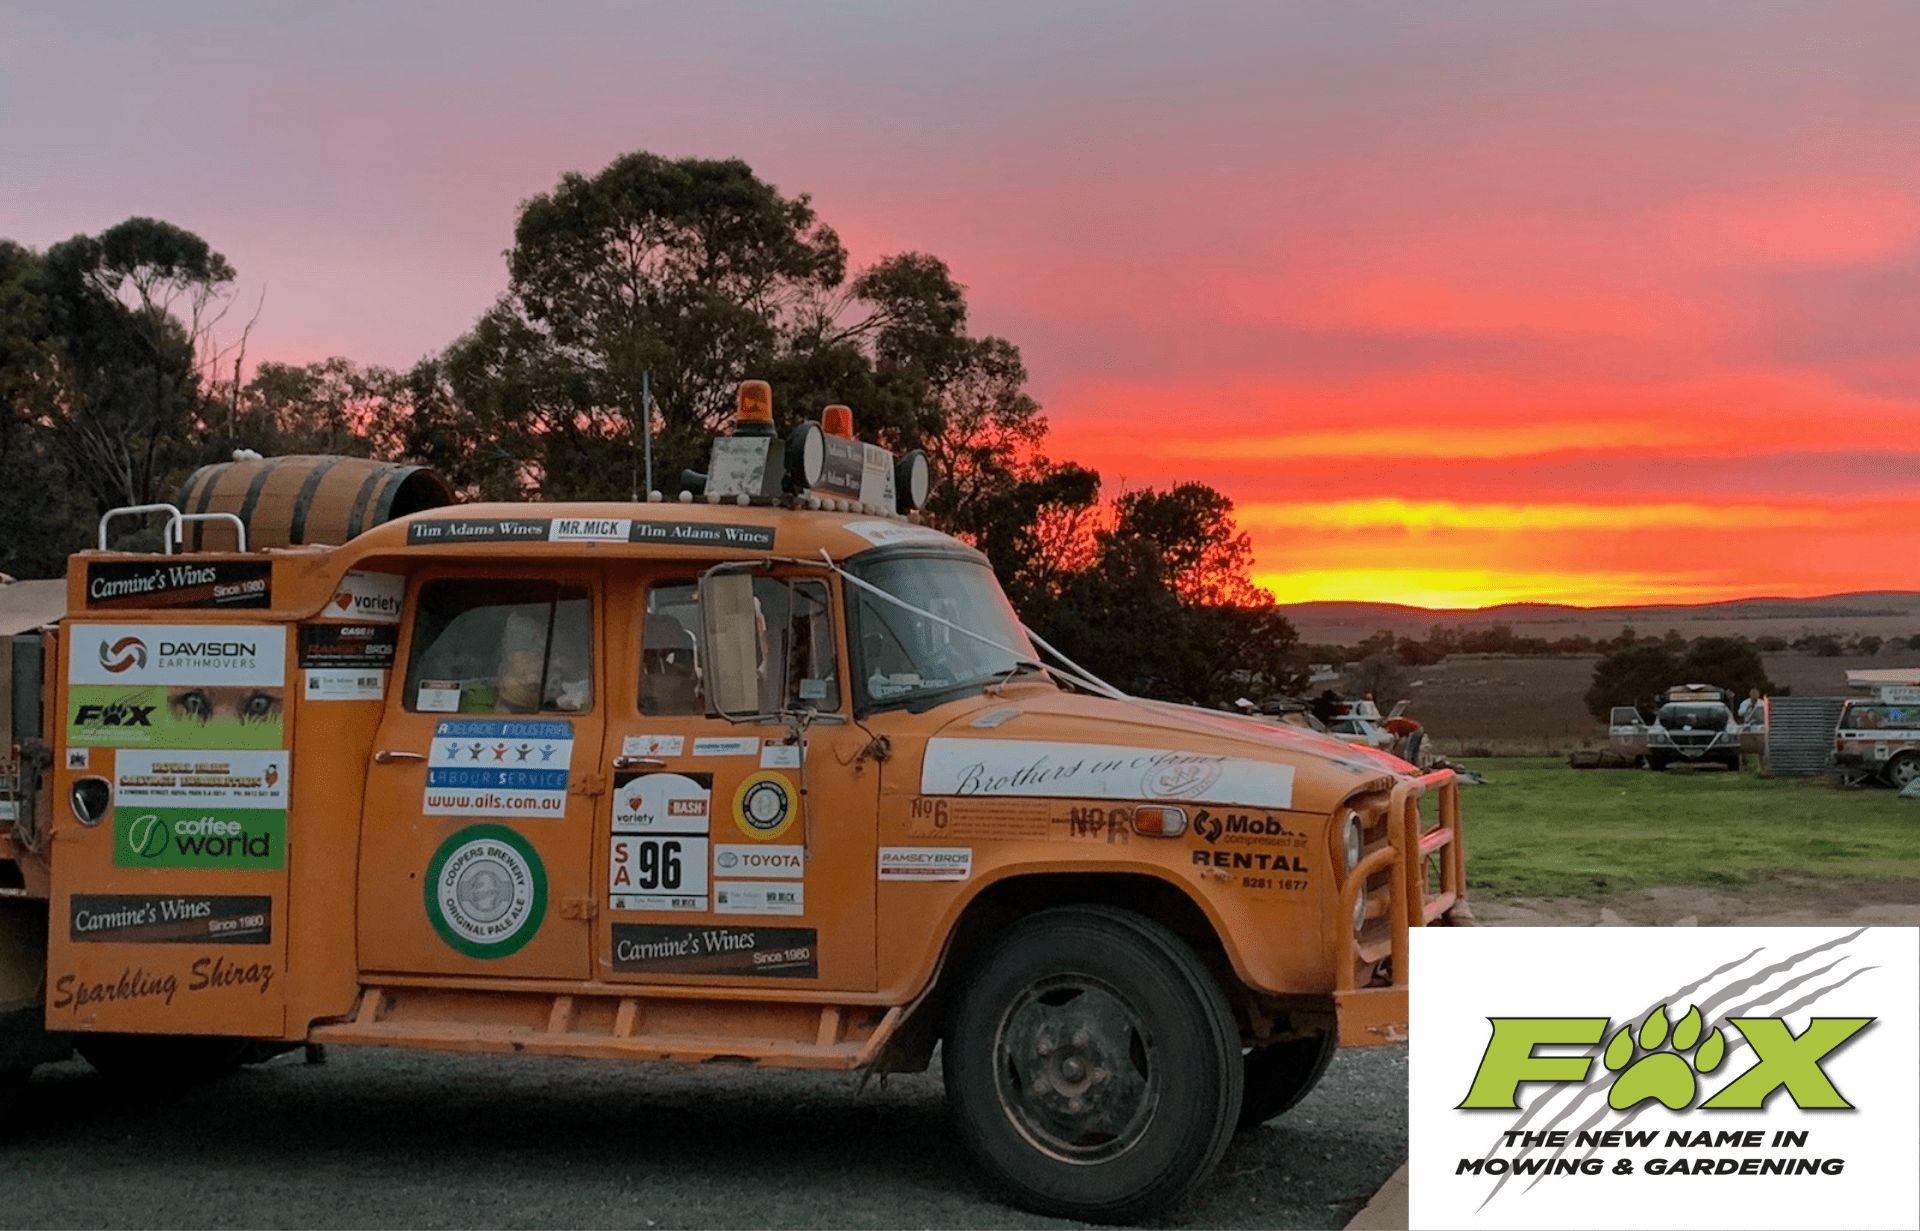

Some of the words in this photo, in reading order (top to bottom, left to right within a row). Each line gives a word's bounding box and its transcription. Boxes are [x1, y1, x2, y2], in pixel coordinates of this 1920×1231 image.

[413, 524, 442, 537] Tim
[446, 523, 495, 536] Adams
[500, 522, 543, 535] Wines
[637, 525, 666, 537] Tim
[671, 526, 721, 540] Adams
[725, 528, 769, 543] Wines
[91, 569, 166, 599] Carmine's
[168, 565, 216, 587] Wines
[213, 585, 239, 597] Since
[354, 594, 401, 614] variety
[160, 642, 256, 656] DAVISON
[158, 658, 256, 669] EARTHMOVERS
[499, 772, 567, 785] SERVICE
[955, 755, 1086, 796] Brothers
[427, 793, 561, 810] www.ails.com.au
[672, 802, 703, 814] BASH
[174, 816, 241, 835] coffee
[616, 813, 654, 825] variety
[174, 831, 270, 857] world
[445, 847, 484, 887] COOPERS
[487, 846, 525, 886] BREWERY
[639, 841, 682, 889] 96
[742, 855, 801, 867] TOYOTA
[1193, 850, 1309, 873] RENTAL
[1278, 879, 1308, 891] 1677
[75, 902, 157, 932] Carmine's
[159, 900, 212, 921] Wines
[209, 918, 237, 931] Since
[239, 915, 264, 927] 1980
[446, 898, 486, 936] ORIGINAL
[488, 918, 513, 935] PALE
[511, 898, 525, 920] ALE
[617, 933, 700, 961] Carmine's
[702, 929, 756, 952] Wines
[753, 952, 782, 965] Since
[784, 948, 811, 961] 1980
[54, 968, 178, 1015] Sparkling
[189, 956, 275, 993] Shiraz
